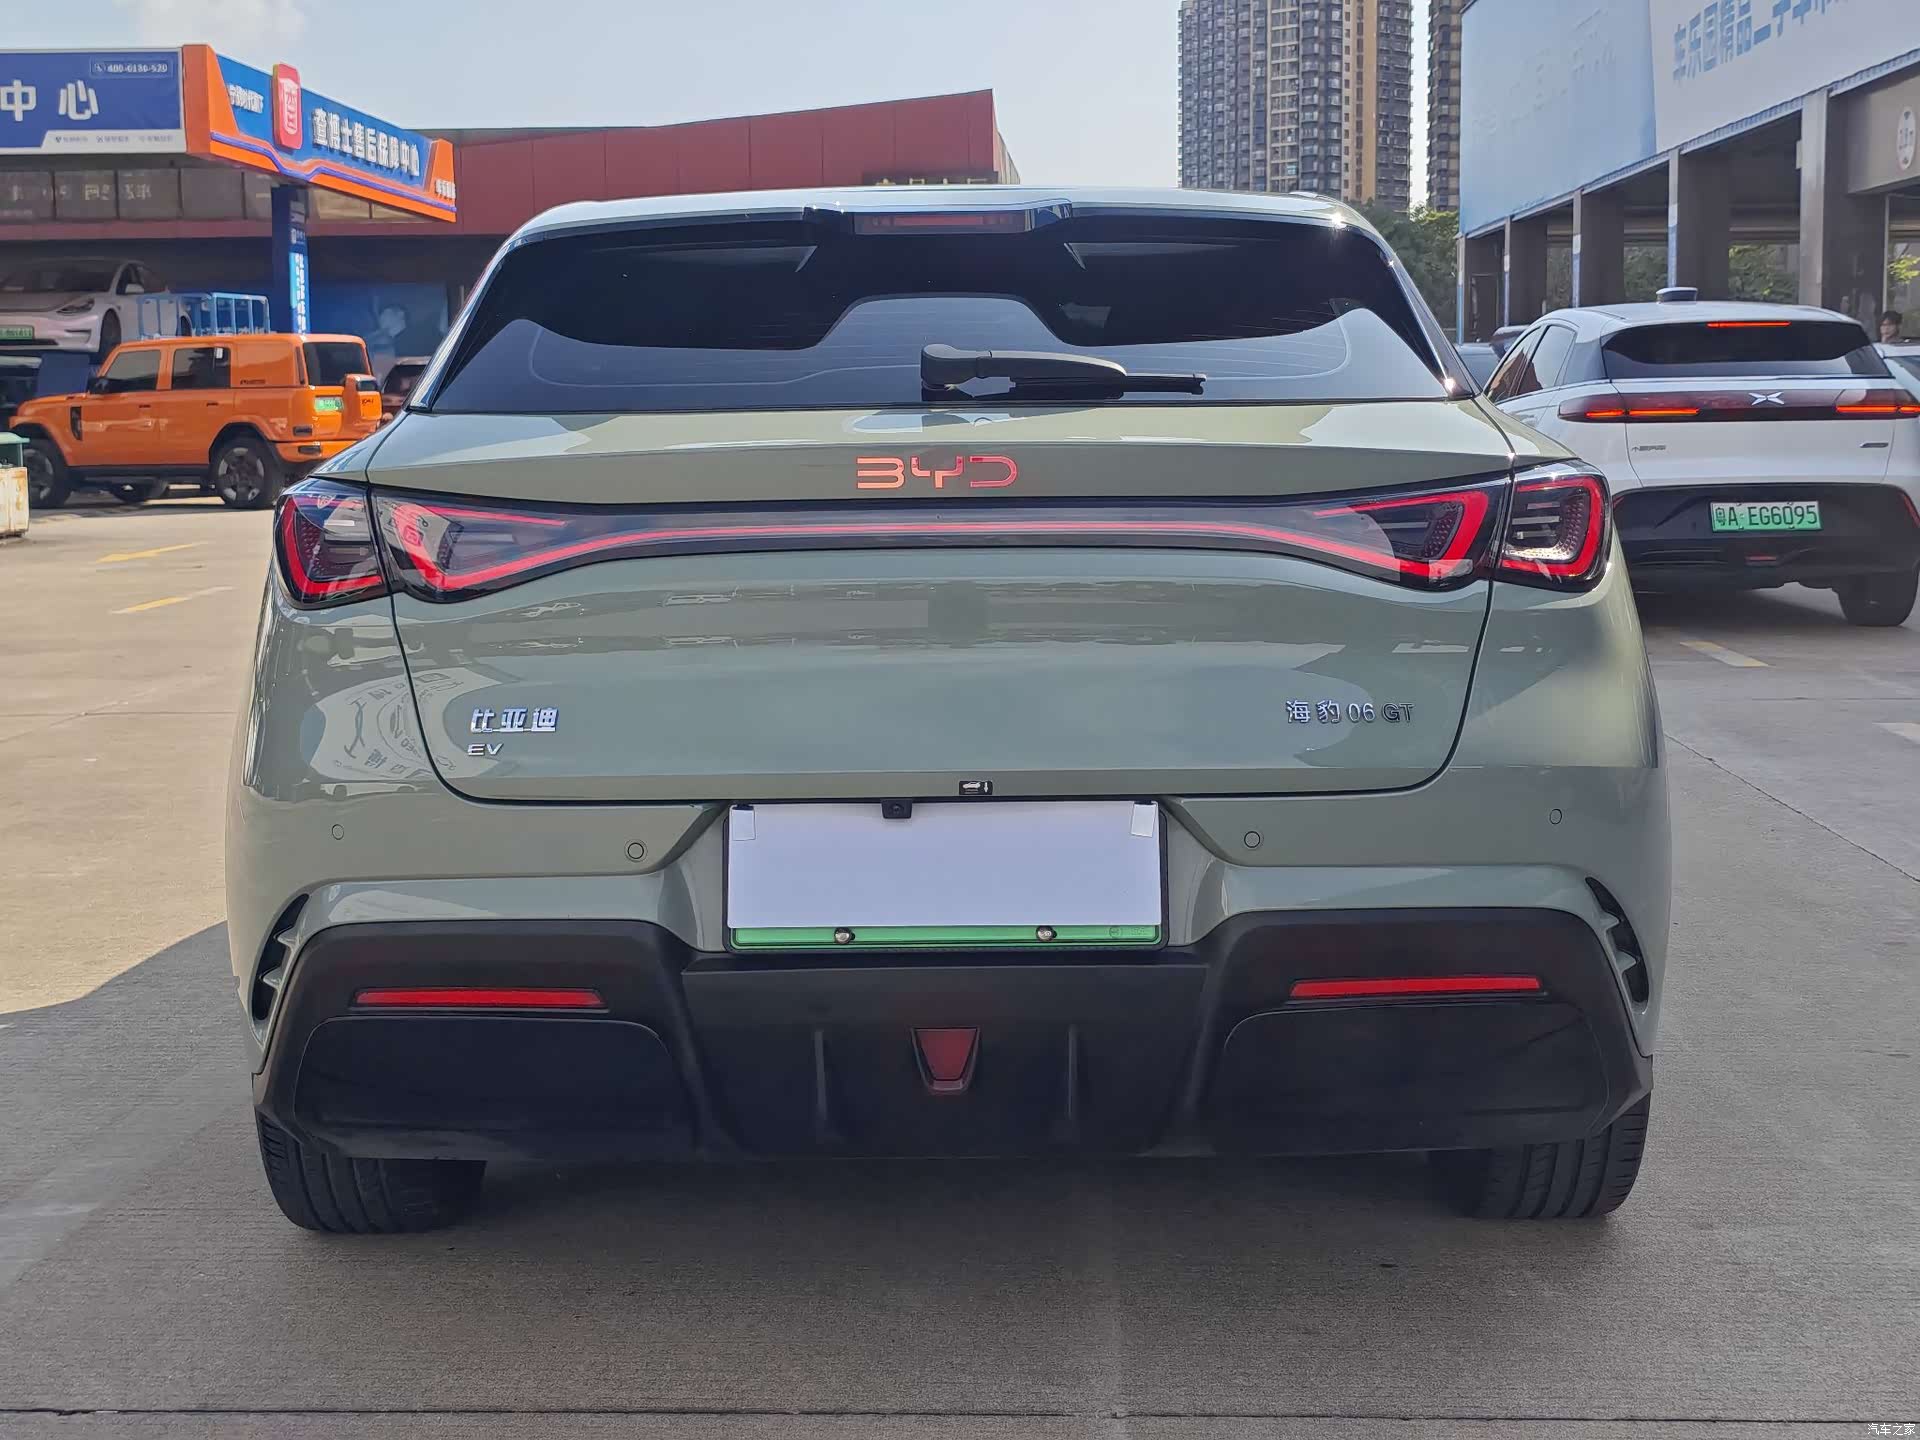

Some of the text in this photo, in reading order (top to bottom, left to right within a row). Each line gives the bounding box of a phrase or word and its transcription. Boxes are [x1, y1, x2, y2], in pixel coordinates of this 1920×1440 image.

[0, 80, 99, 121] 中心
[856, 456, 1018, 489] BYD
[1748, 505, 1818, 526] EG6095
[470, 708, 558, 733] 比亚迪
[1383, 703, 1415, 722] GT
[468, 743, 505, 756] EV
